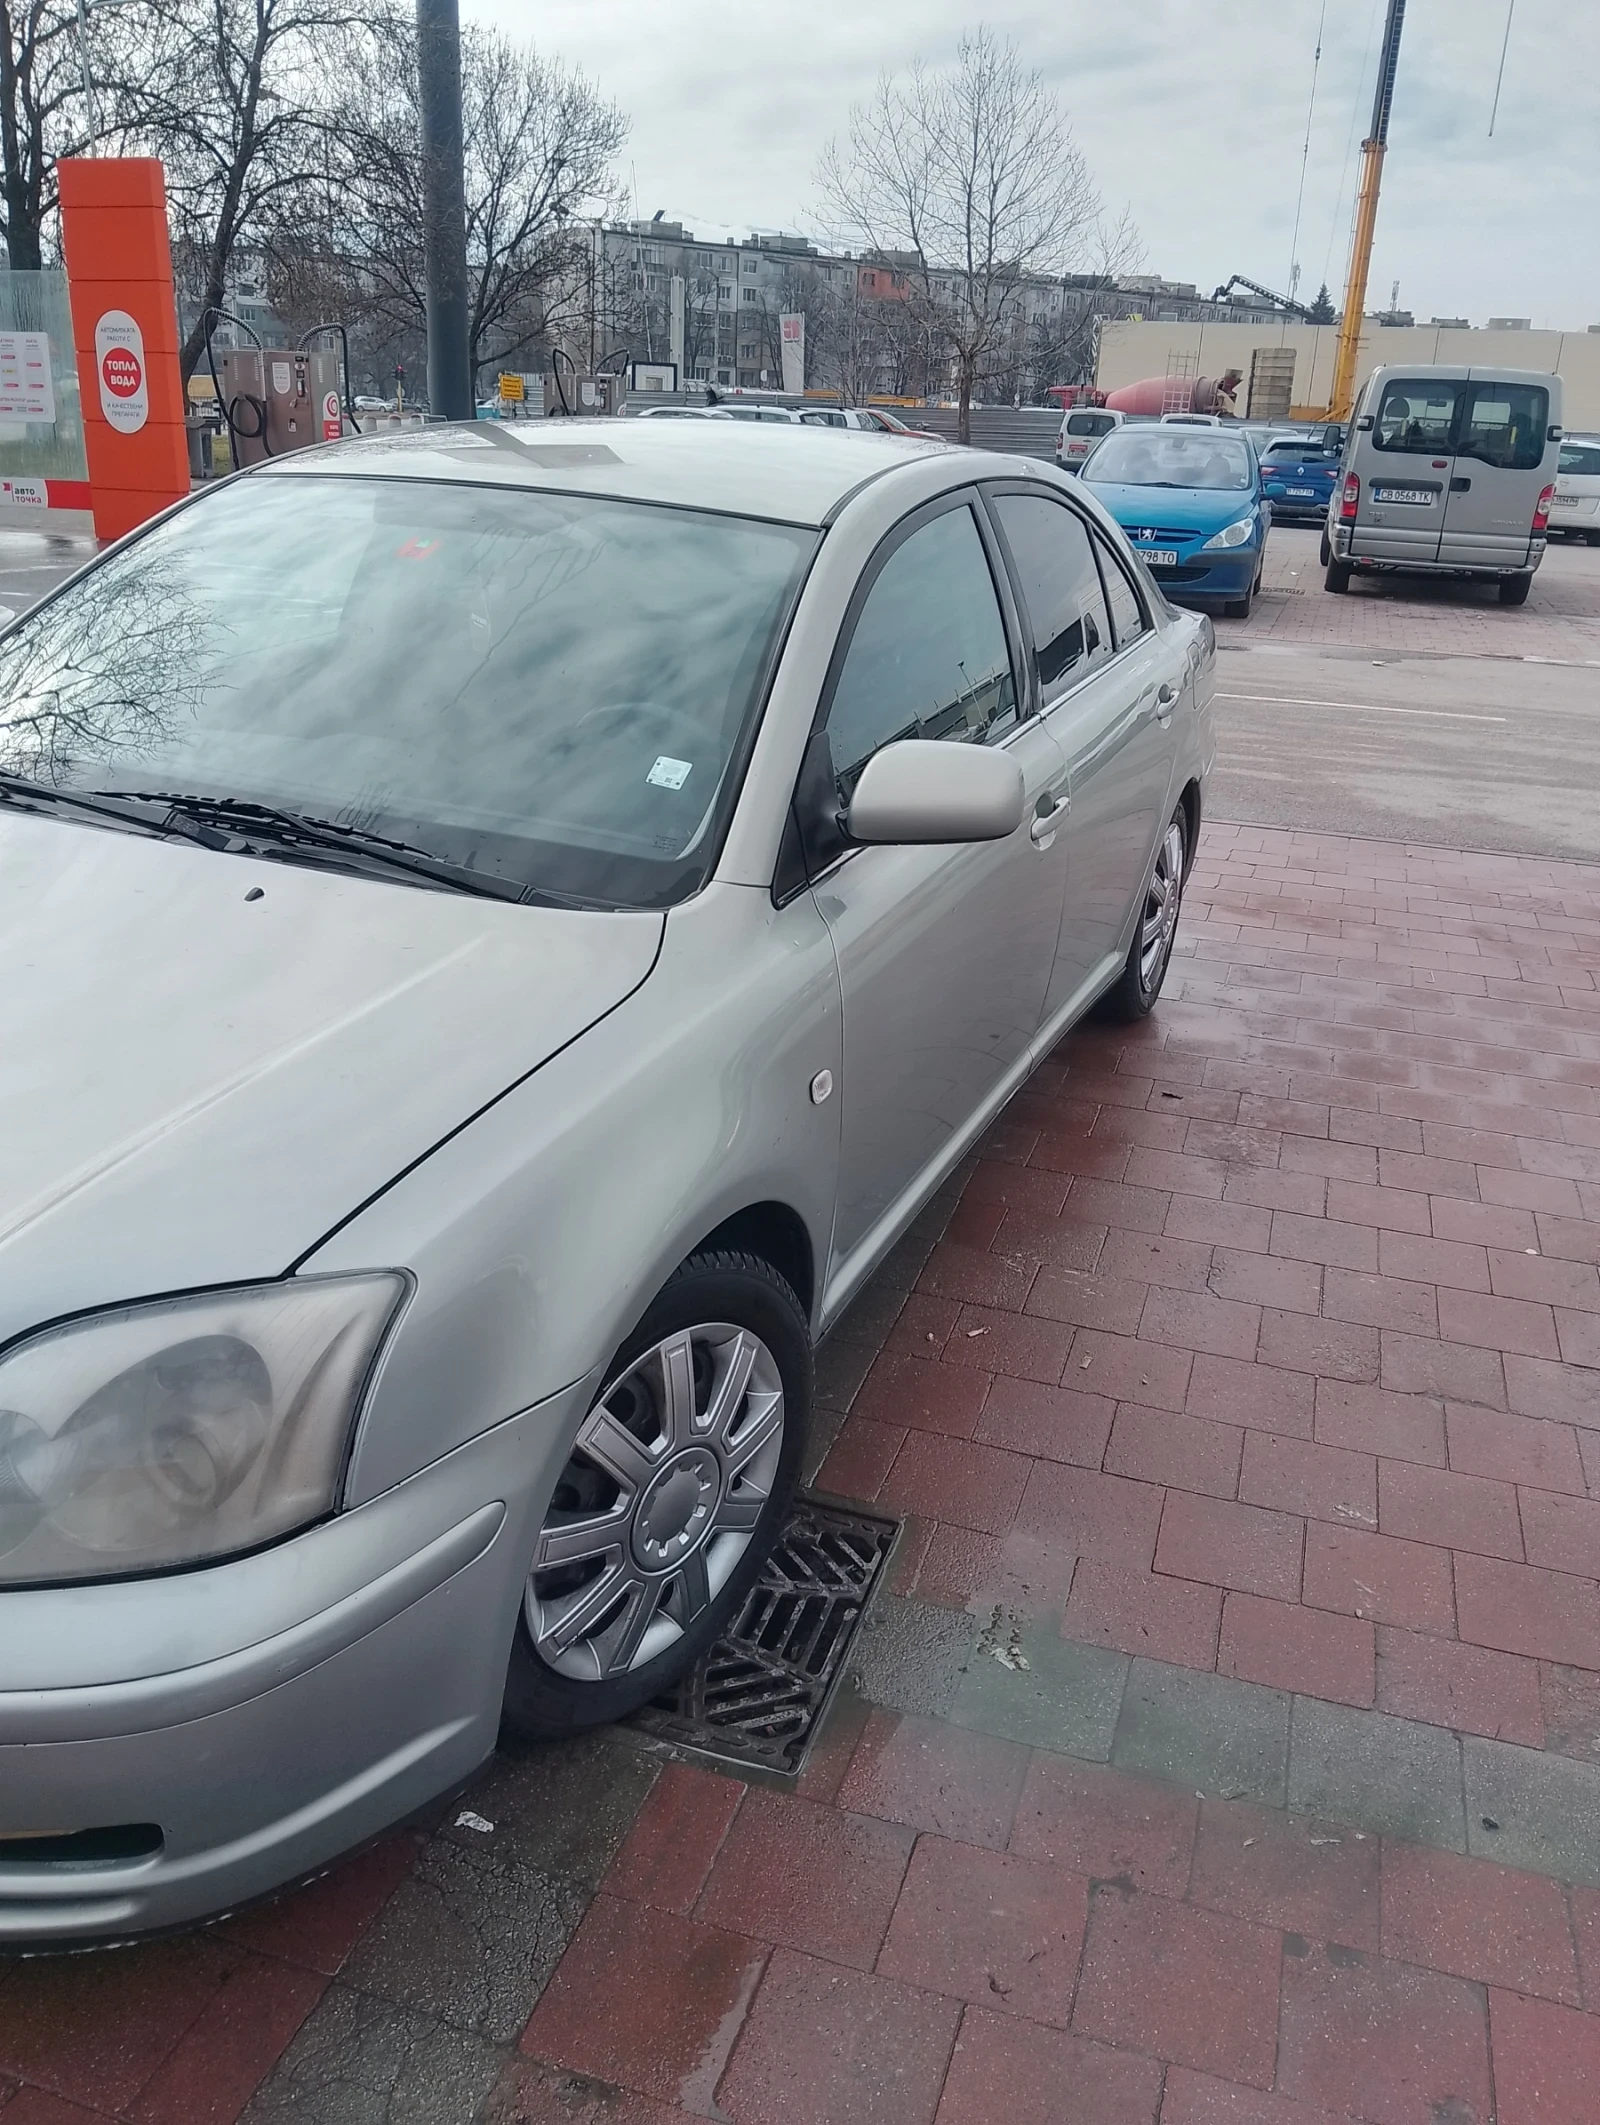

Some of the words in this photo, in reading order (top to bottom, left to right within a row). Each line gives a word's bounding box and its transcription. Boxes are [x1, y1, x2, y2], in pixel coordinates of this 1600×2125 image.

[106, 360, 137, 371] ТОПЛА
[110, 375, 136, 387] ВОДА
[14, 488, 35, 496] авто
[1381, 490, 1393, 500] CB
[1395, 491, 1416, 501] 0568
[1419, 492, 1431, 502] TK
[1138, 551, 1158, 562] 798
[1161, 552, 1175, 564] TO
